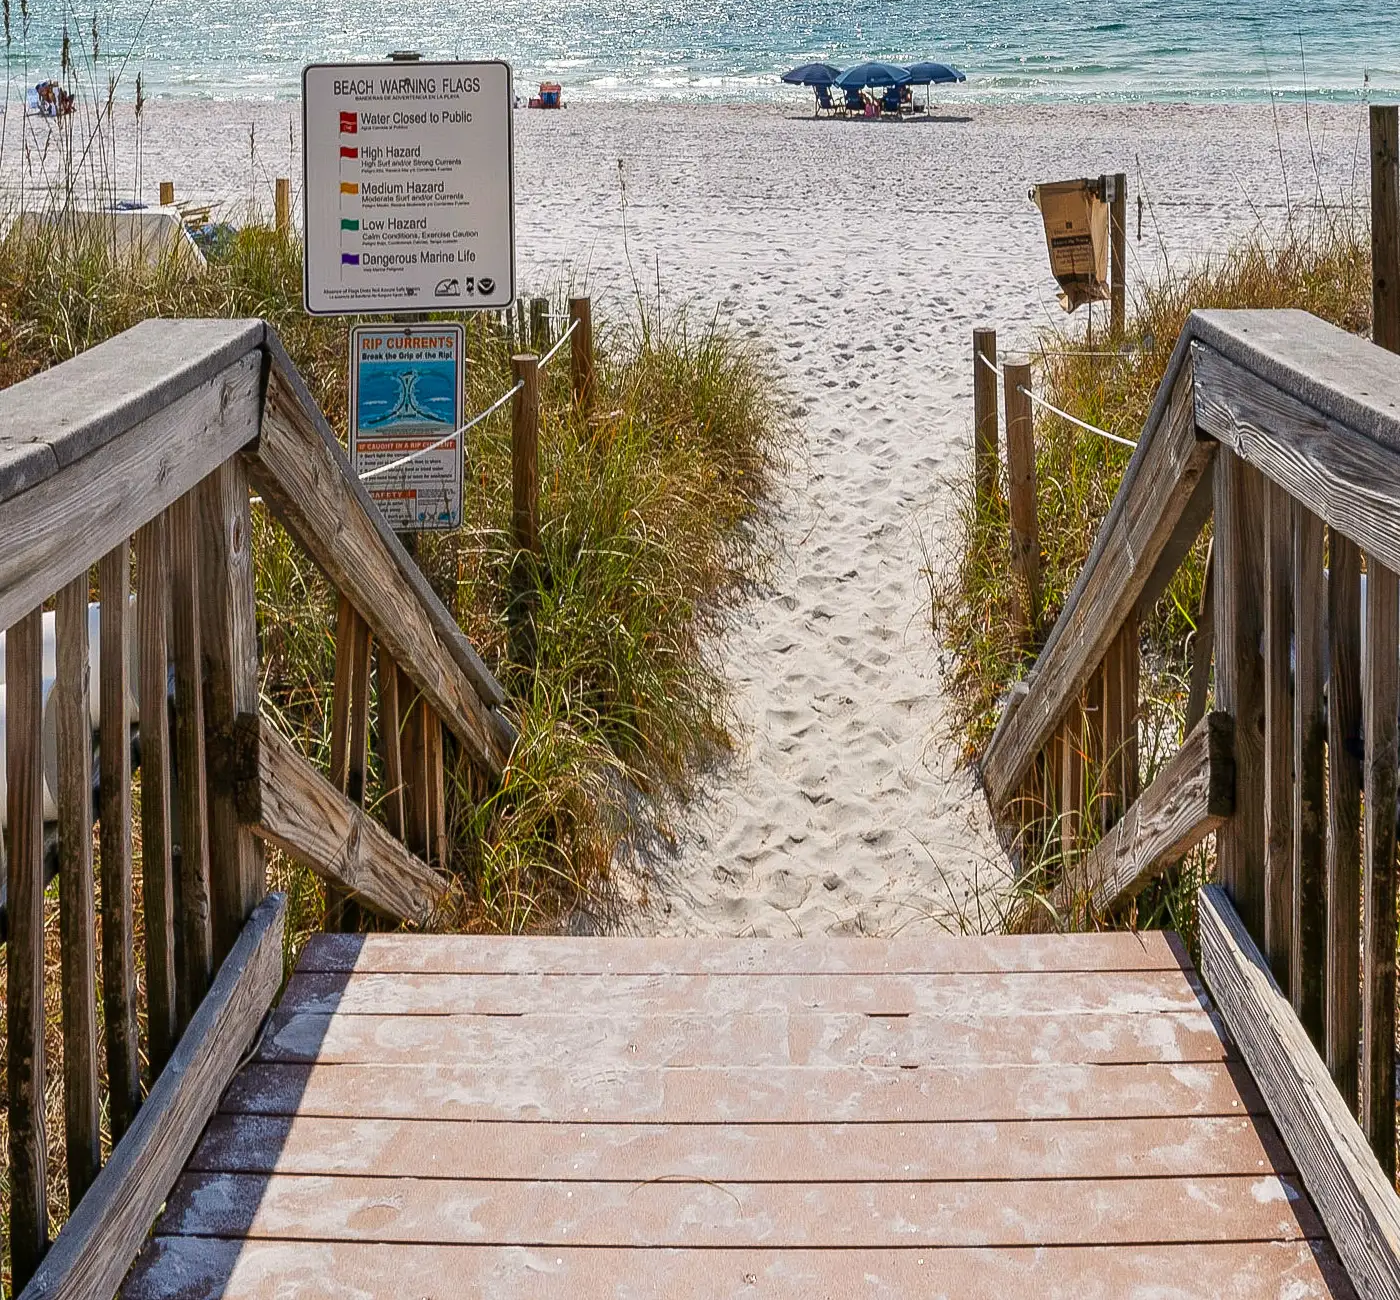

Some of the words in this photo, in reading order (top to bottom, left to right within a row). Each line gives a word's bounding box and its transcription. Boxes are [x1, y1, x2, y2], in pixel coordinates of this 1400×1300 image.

[334, 80, 374, 95] BEACH
[380, 78, 436, 94] WARNING
[442, 77, 480, 93] FLAGS
[361, 112, 390, 124] Water
[393, 111, 427, 124] Closed
[430, 112, 439, 123] to
[442, 111, 472, 123] Public
[361, 146, 383, 160] High
[386, 145, 420, 158] Hazard
[361, 182, 403, 194] Medium
[407, 181, 444, 193] Hazard
[396, 194, 409, 202] Surf
[362, 219, 384, 230] Low
[388, 217, 427, 229] Hazard
[422, 231, 450, 239] Exercise
[362, 253, 417, 267] Dangerous
[421, 250, 454, 263] Marine
[458, 249, 476, 262] Life
[362, 337, 382, 349] RIP
[387, 336, 453, 349] CURRENTS
[385, 352, 397, 360] the
[400, 351, 414, 360] Grip
[416, 351, 423, 359] of
[425, 351, 436, 359] the
